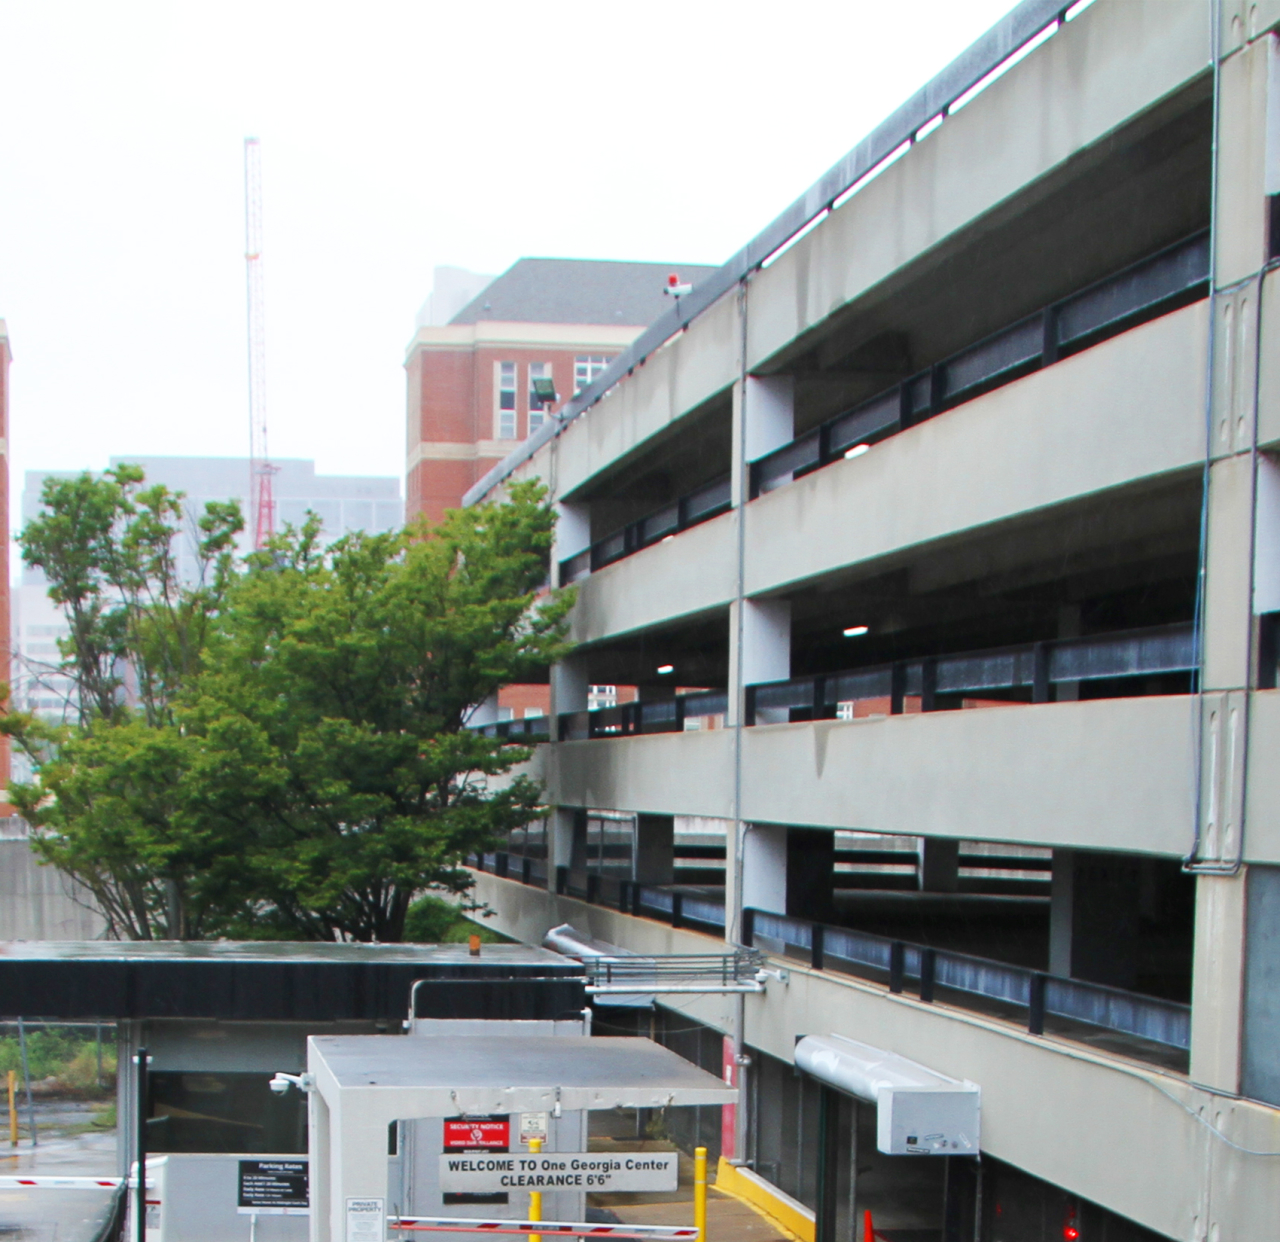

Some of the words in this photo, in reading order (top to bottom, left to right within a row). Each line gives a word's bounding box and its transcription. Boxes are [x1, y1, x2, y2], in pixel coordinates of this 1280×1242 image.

[448, 1160, 514, 1172] WELCOME
[520, 1160, 537, 1171] TO
[541, 1160, 566, 1171] One
[571, 1159, 621, 1173] Georgia
[625, 1159, 669, 1171] Center
[501, 1175, 582, 1187] CLEARANCE
[587, 1175, 612, 1186] 6'6"
